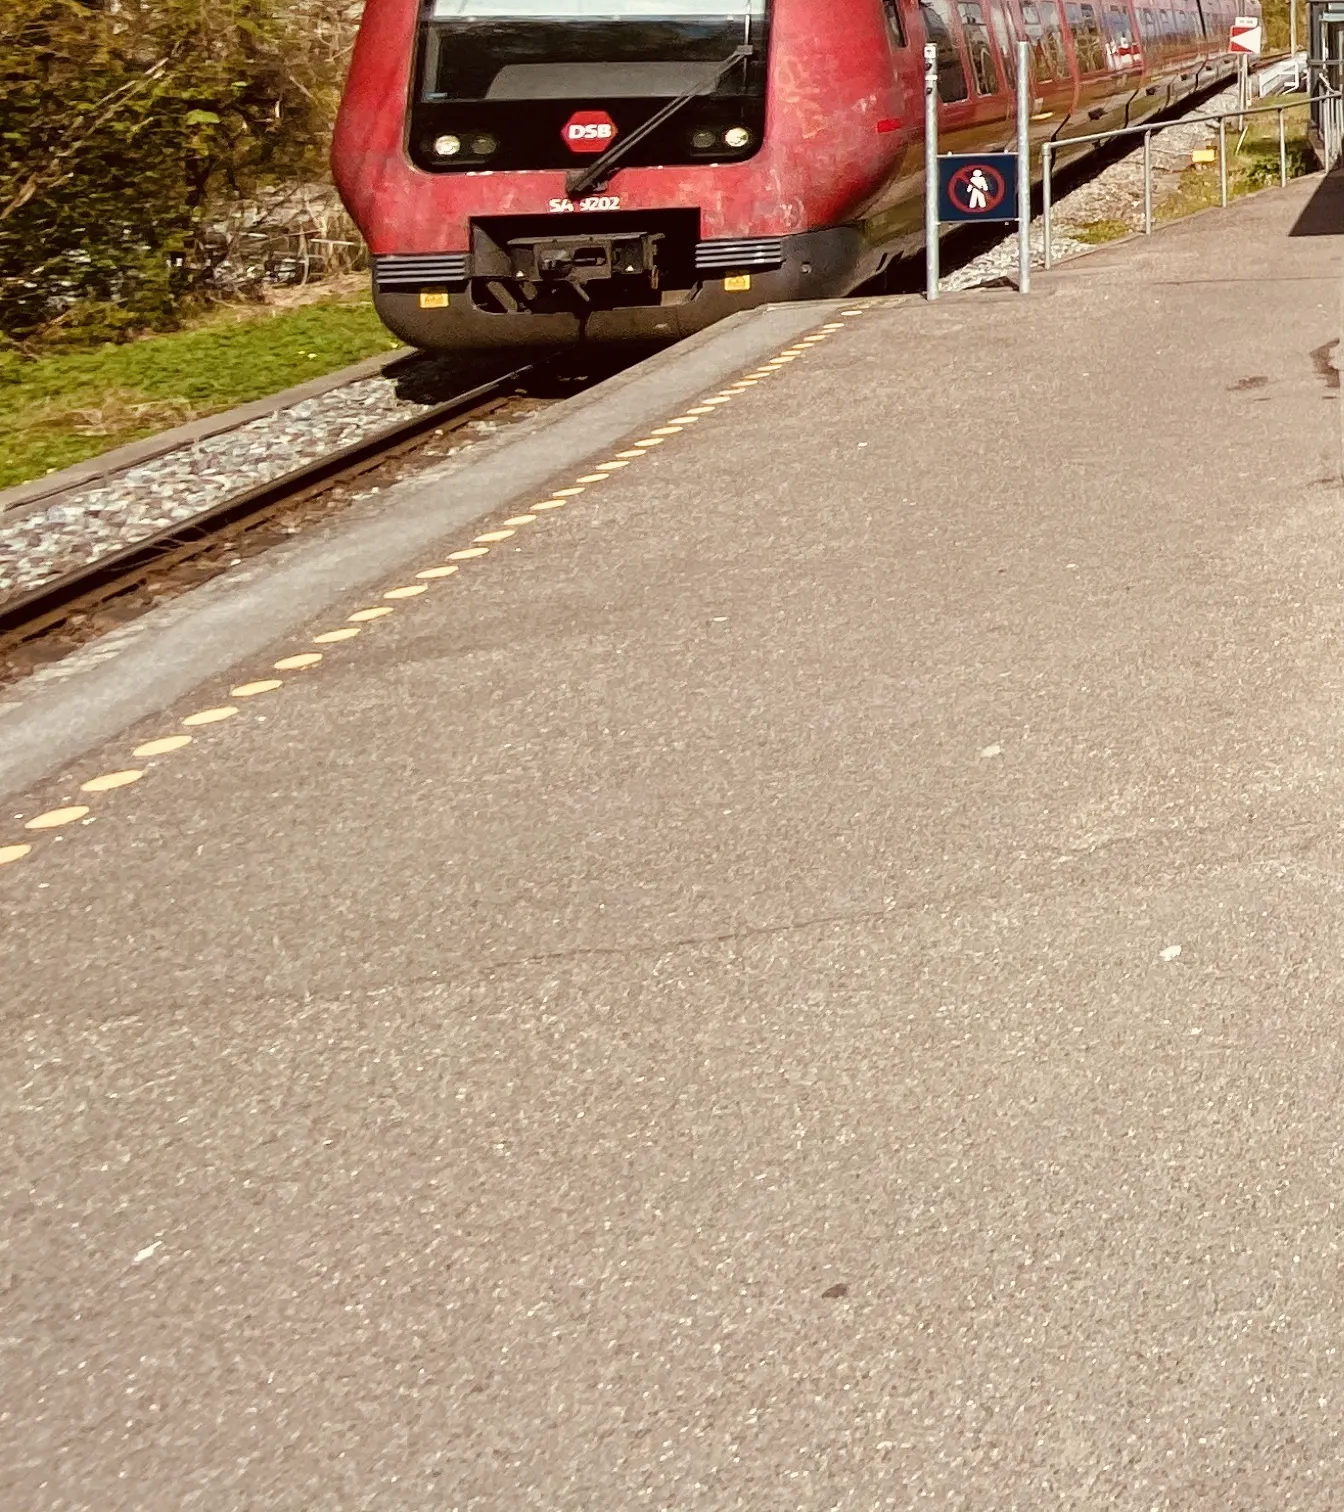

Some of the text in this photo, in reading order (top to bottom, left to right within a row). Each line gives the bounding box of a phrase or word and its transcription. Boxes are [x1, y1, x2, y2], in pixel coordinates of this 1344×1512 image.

[568, 123, 612, 139] DSB
[549, 196, 620, 213] SA 9202
